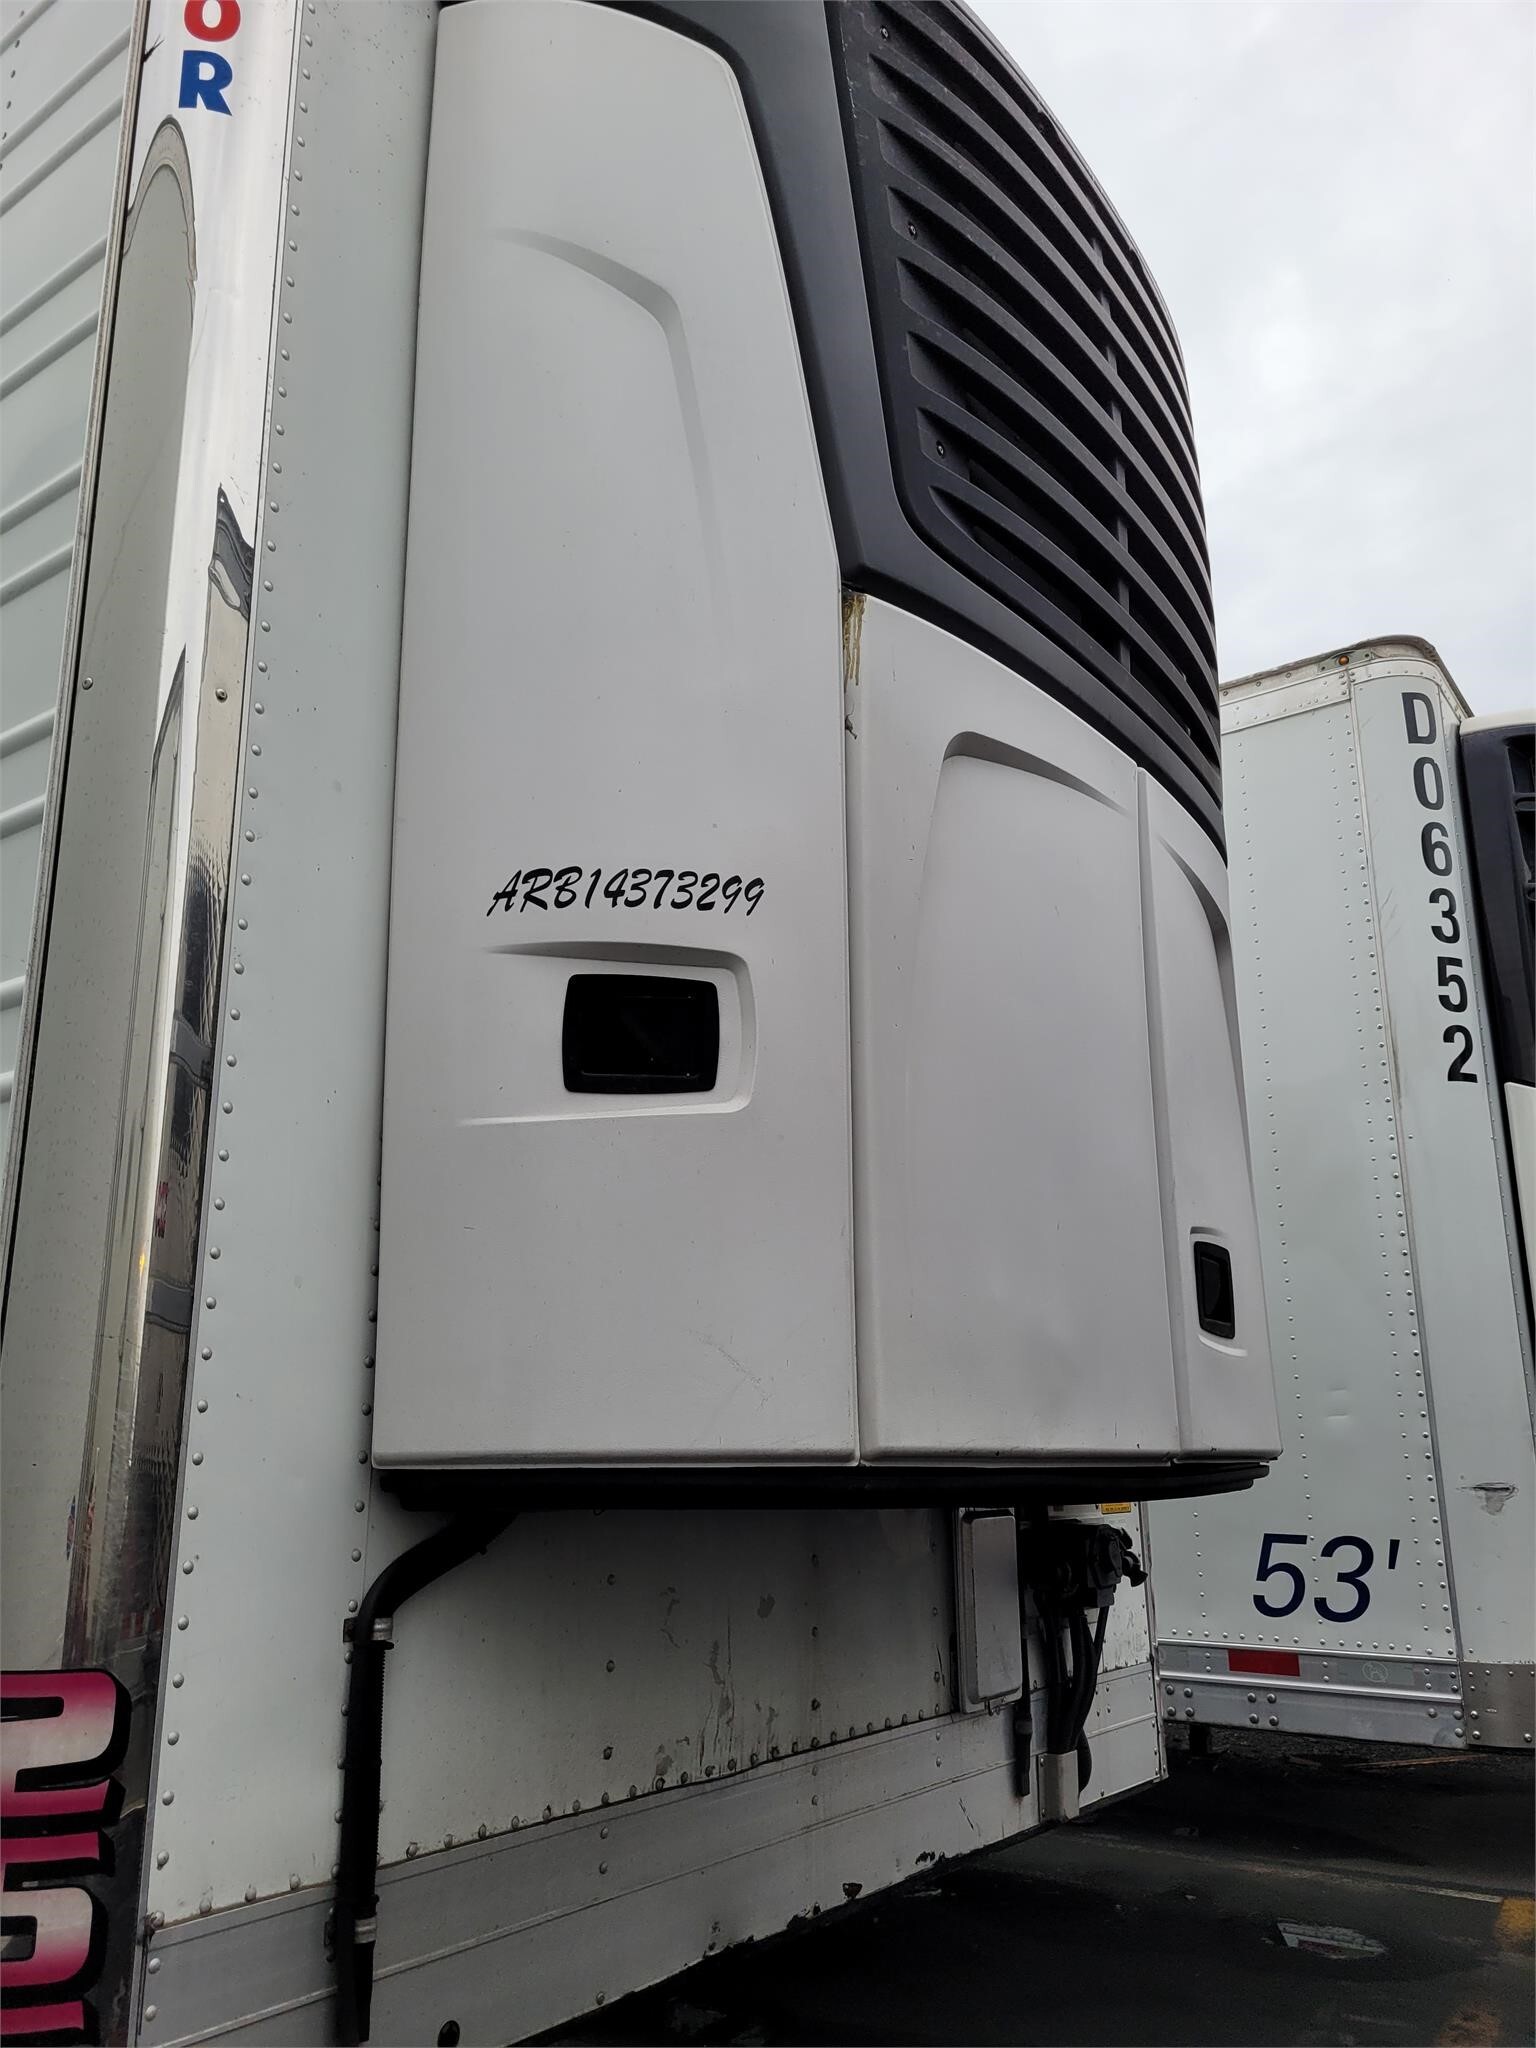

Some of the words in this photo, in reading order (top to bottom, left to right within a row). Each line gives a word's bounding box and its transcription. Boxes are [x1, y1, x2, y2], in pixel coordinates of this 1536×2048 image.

[486, 865, 765, 917] ARB14373299
[1401, 692, 1478, 1083] D06352
[1252, 1532, 1401, 1623] 53'
